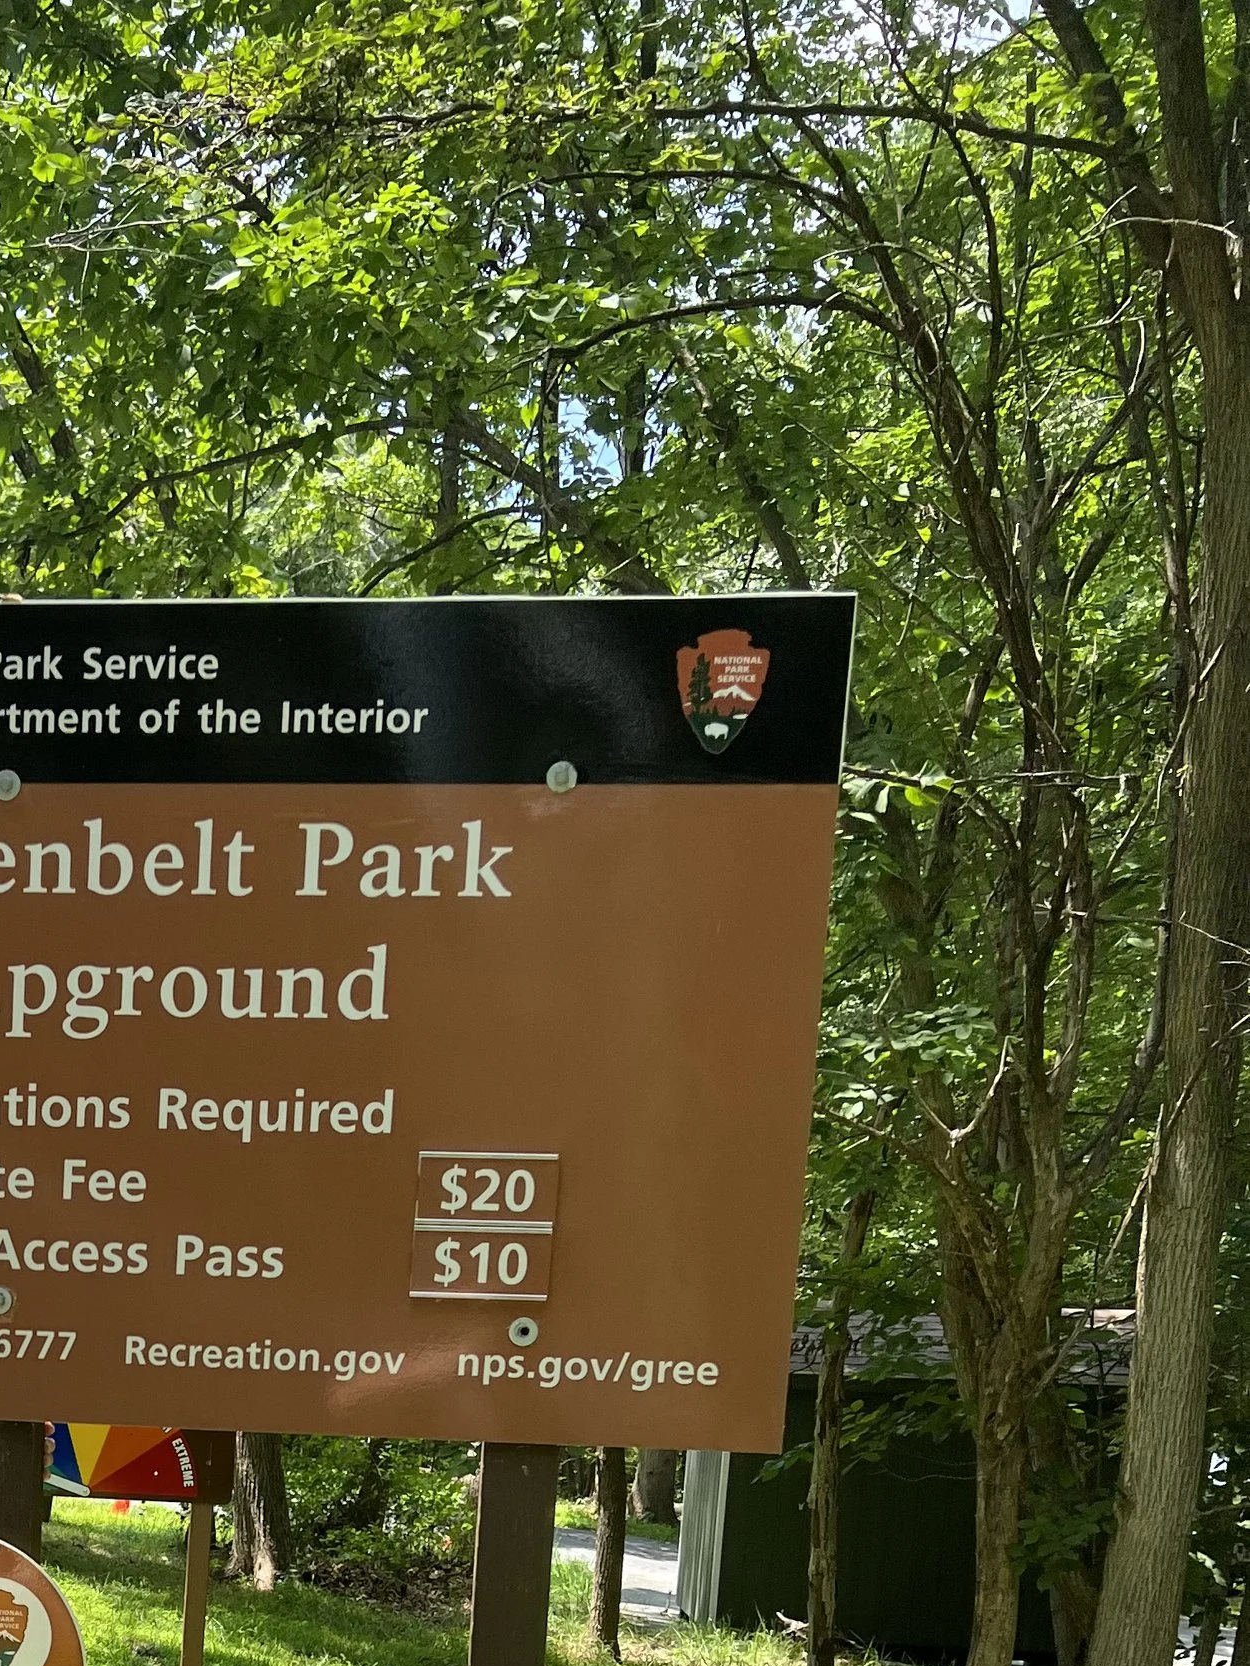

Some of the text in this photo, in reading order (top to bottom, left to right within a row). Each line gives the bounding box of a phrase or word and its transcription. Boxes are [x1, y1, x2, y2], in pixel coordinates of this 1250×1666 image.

[83, 645, 219, 680] Service
[714, 656, 762, 664] NATIONAL
[717, 674, 756, 683] SERVICE
[725, 665, 750, 673] PARK
[139, 698, 181, 734] of
[197, 698, 261, 734] the
[281, 698, 429, 734] Interior
[295, 819, 514, 898] Park
[158, 1087, 394, 1143] Required
[62, 1158, 147, 1203] Fee
[440, 1163, 536, 1215] $20
[175, 1234, 284, 1279] Pass
[433, 1236, 529, 1288] $10
[125, 1335, 406, 1382] Recreation.gov
[457, 1351, 719, 1392] nps.gov/gree
[171, 1437, 195, 1488] EXTREME
